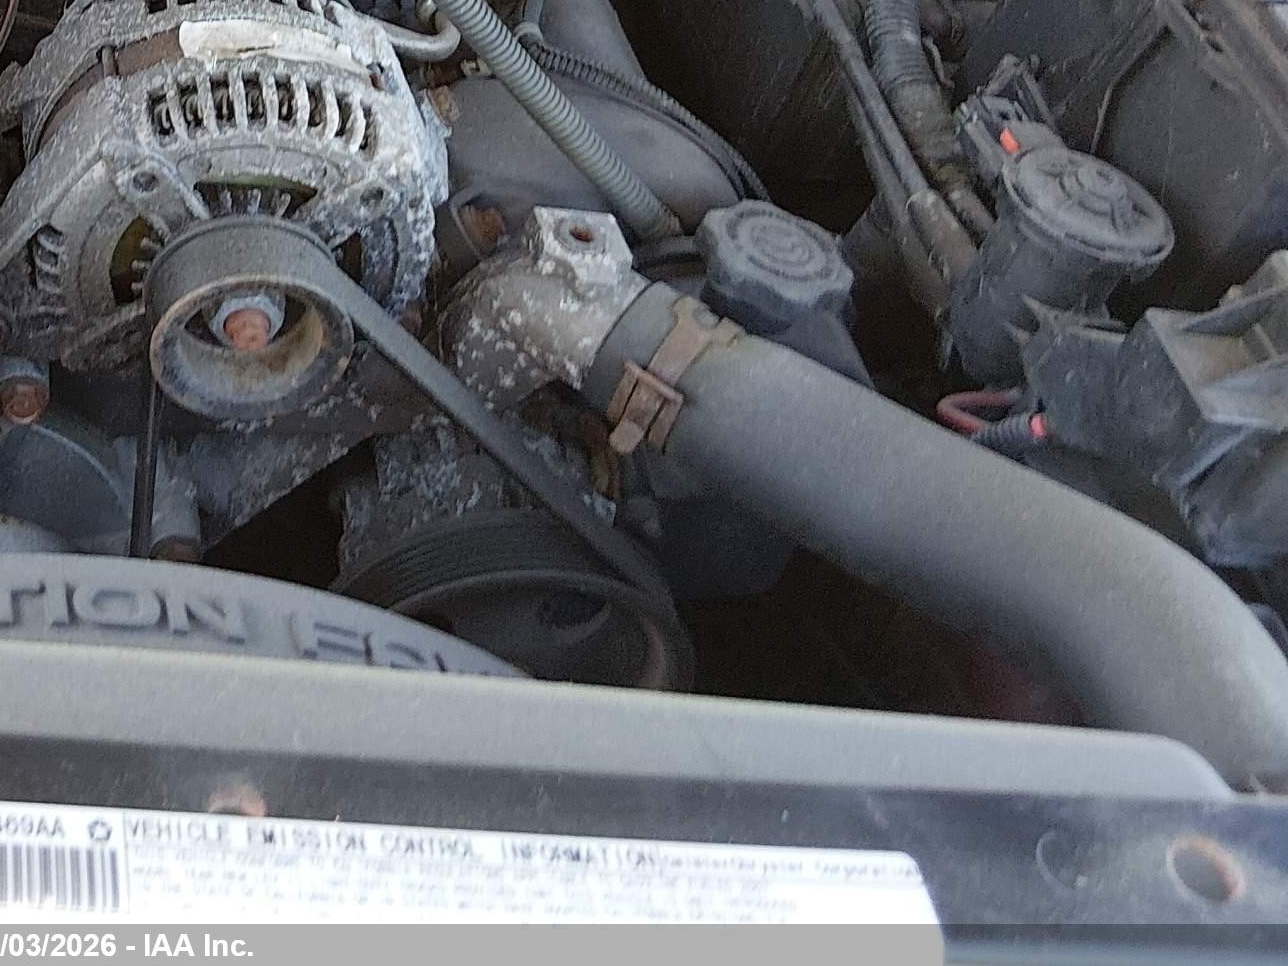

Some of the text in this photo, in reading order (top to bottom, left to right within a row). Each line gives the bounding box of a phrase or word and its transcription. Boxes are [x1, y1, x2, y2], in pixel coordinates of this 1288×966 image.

[128, 818, 230, 845] VEHICLE
[246, 823, 368, 852] EMISSION
[379, 830, 484, 860] CONTROL
[500, 837, 656, 867] INFORMATION
